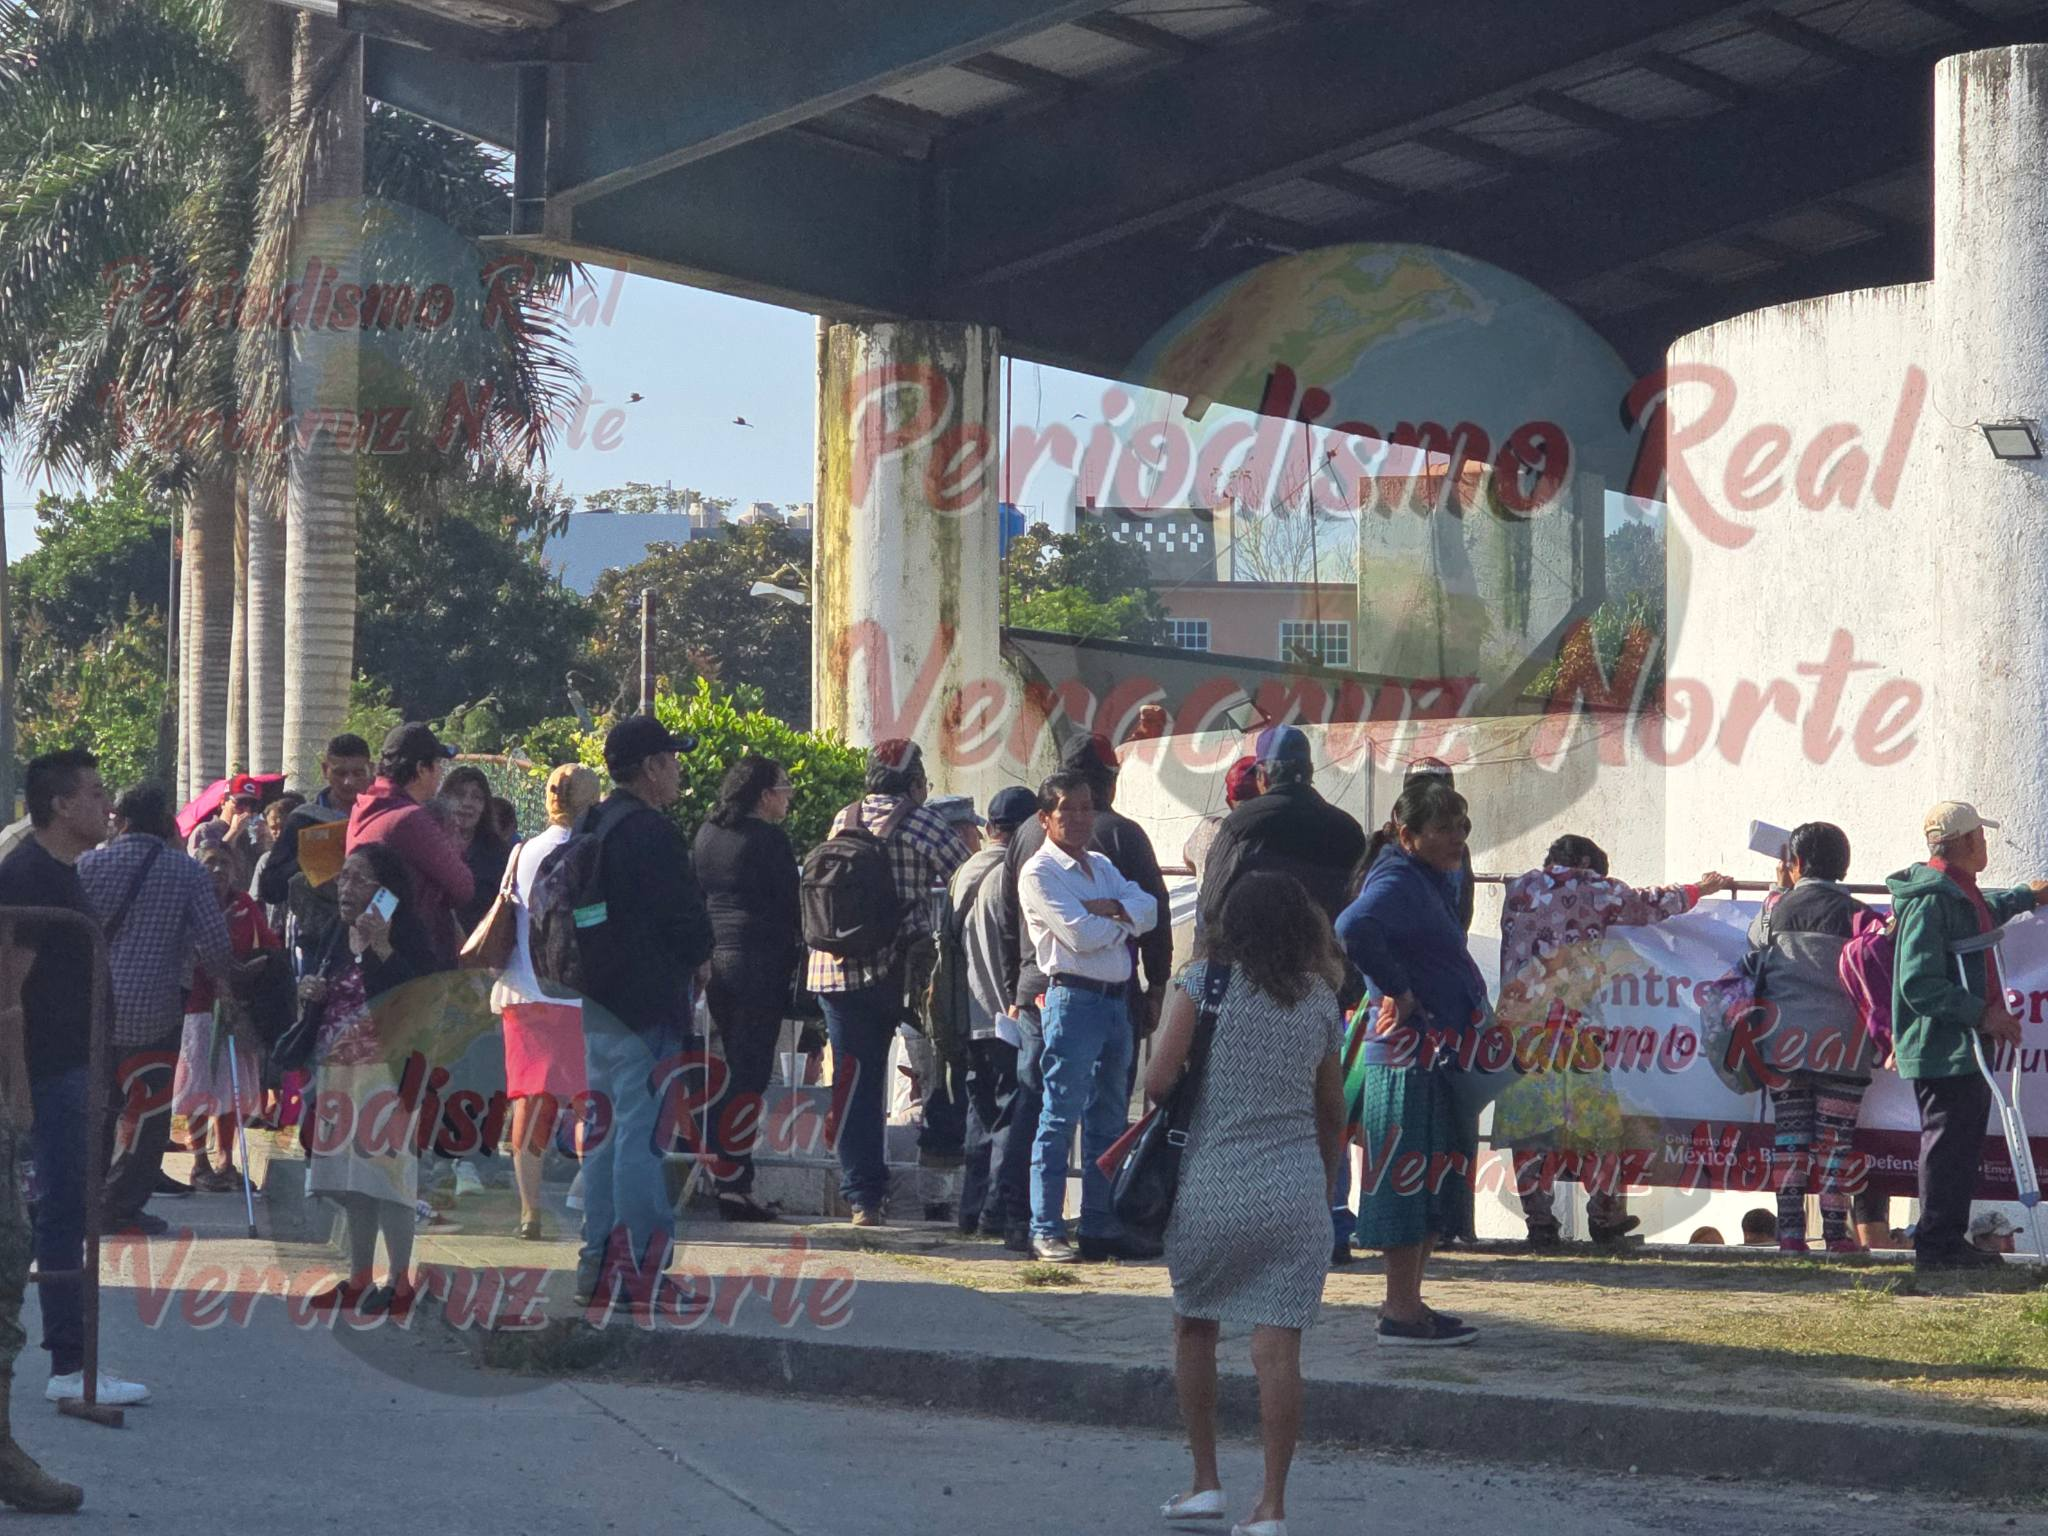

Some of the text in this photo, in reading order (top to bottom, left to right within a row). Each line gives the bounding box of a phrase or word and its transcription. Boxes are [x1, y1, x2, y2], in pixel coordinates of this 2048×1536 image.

[1600, 967, 1714, 1007] ntre
[1664, 1145, 1738, 1167] México
[1865, 1154, 1920, 1171] Defens
